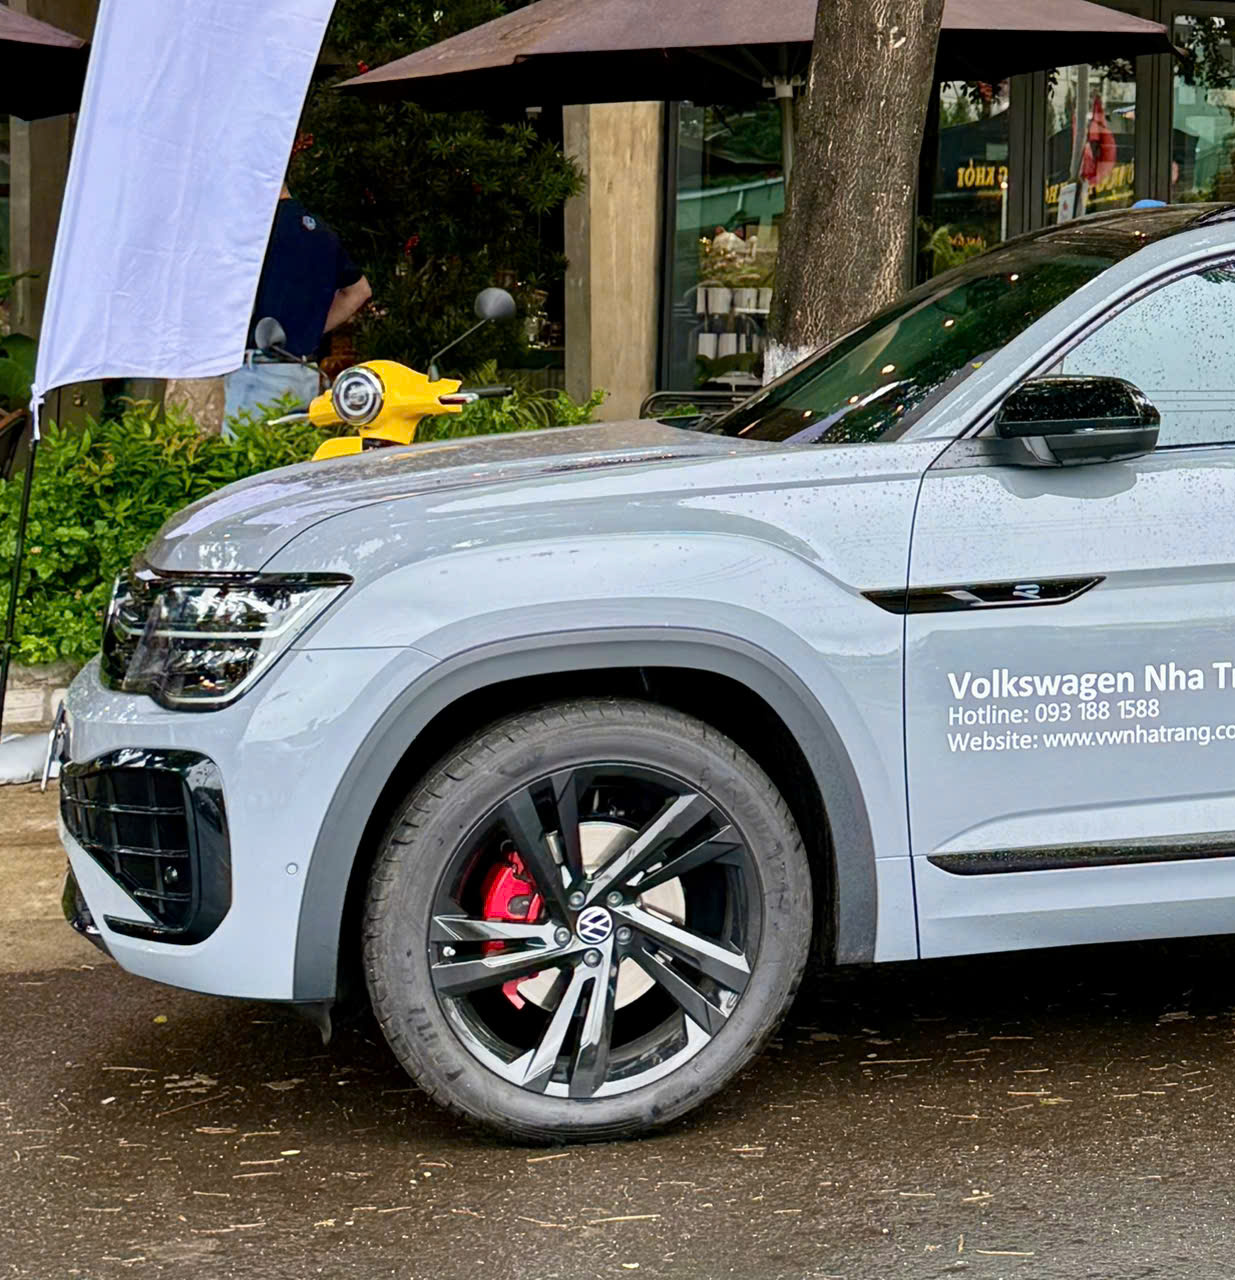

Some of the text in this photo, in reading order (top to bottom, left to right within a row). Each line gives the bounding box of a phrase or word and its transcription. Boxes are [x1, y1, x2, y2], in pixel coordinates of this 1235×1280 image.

[947, 668, 1135, 701] Volkswagen
[1144, 661, 1204, 693] Nha
[948, 698, 1161, 727] Hotline: 093 188 1588
[947, 730, 1039, 753] Website:
